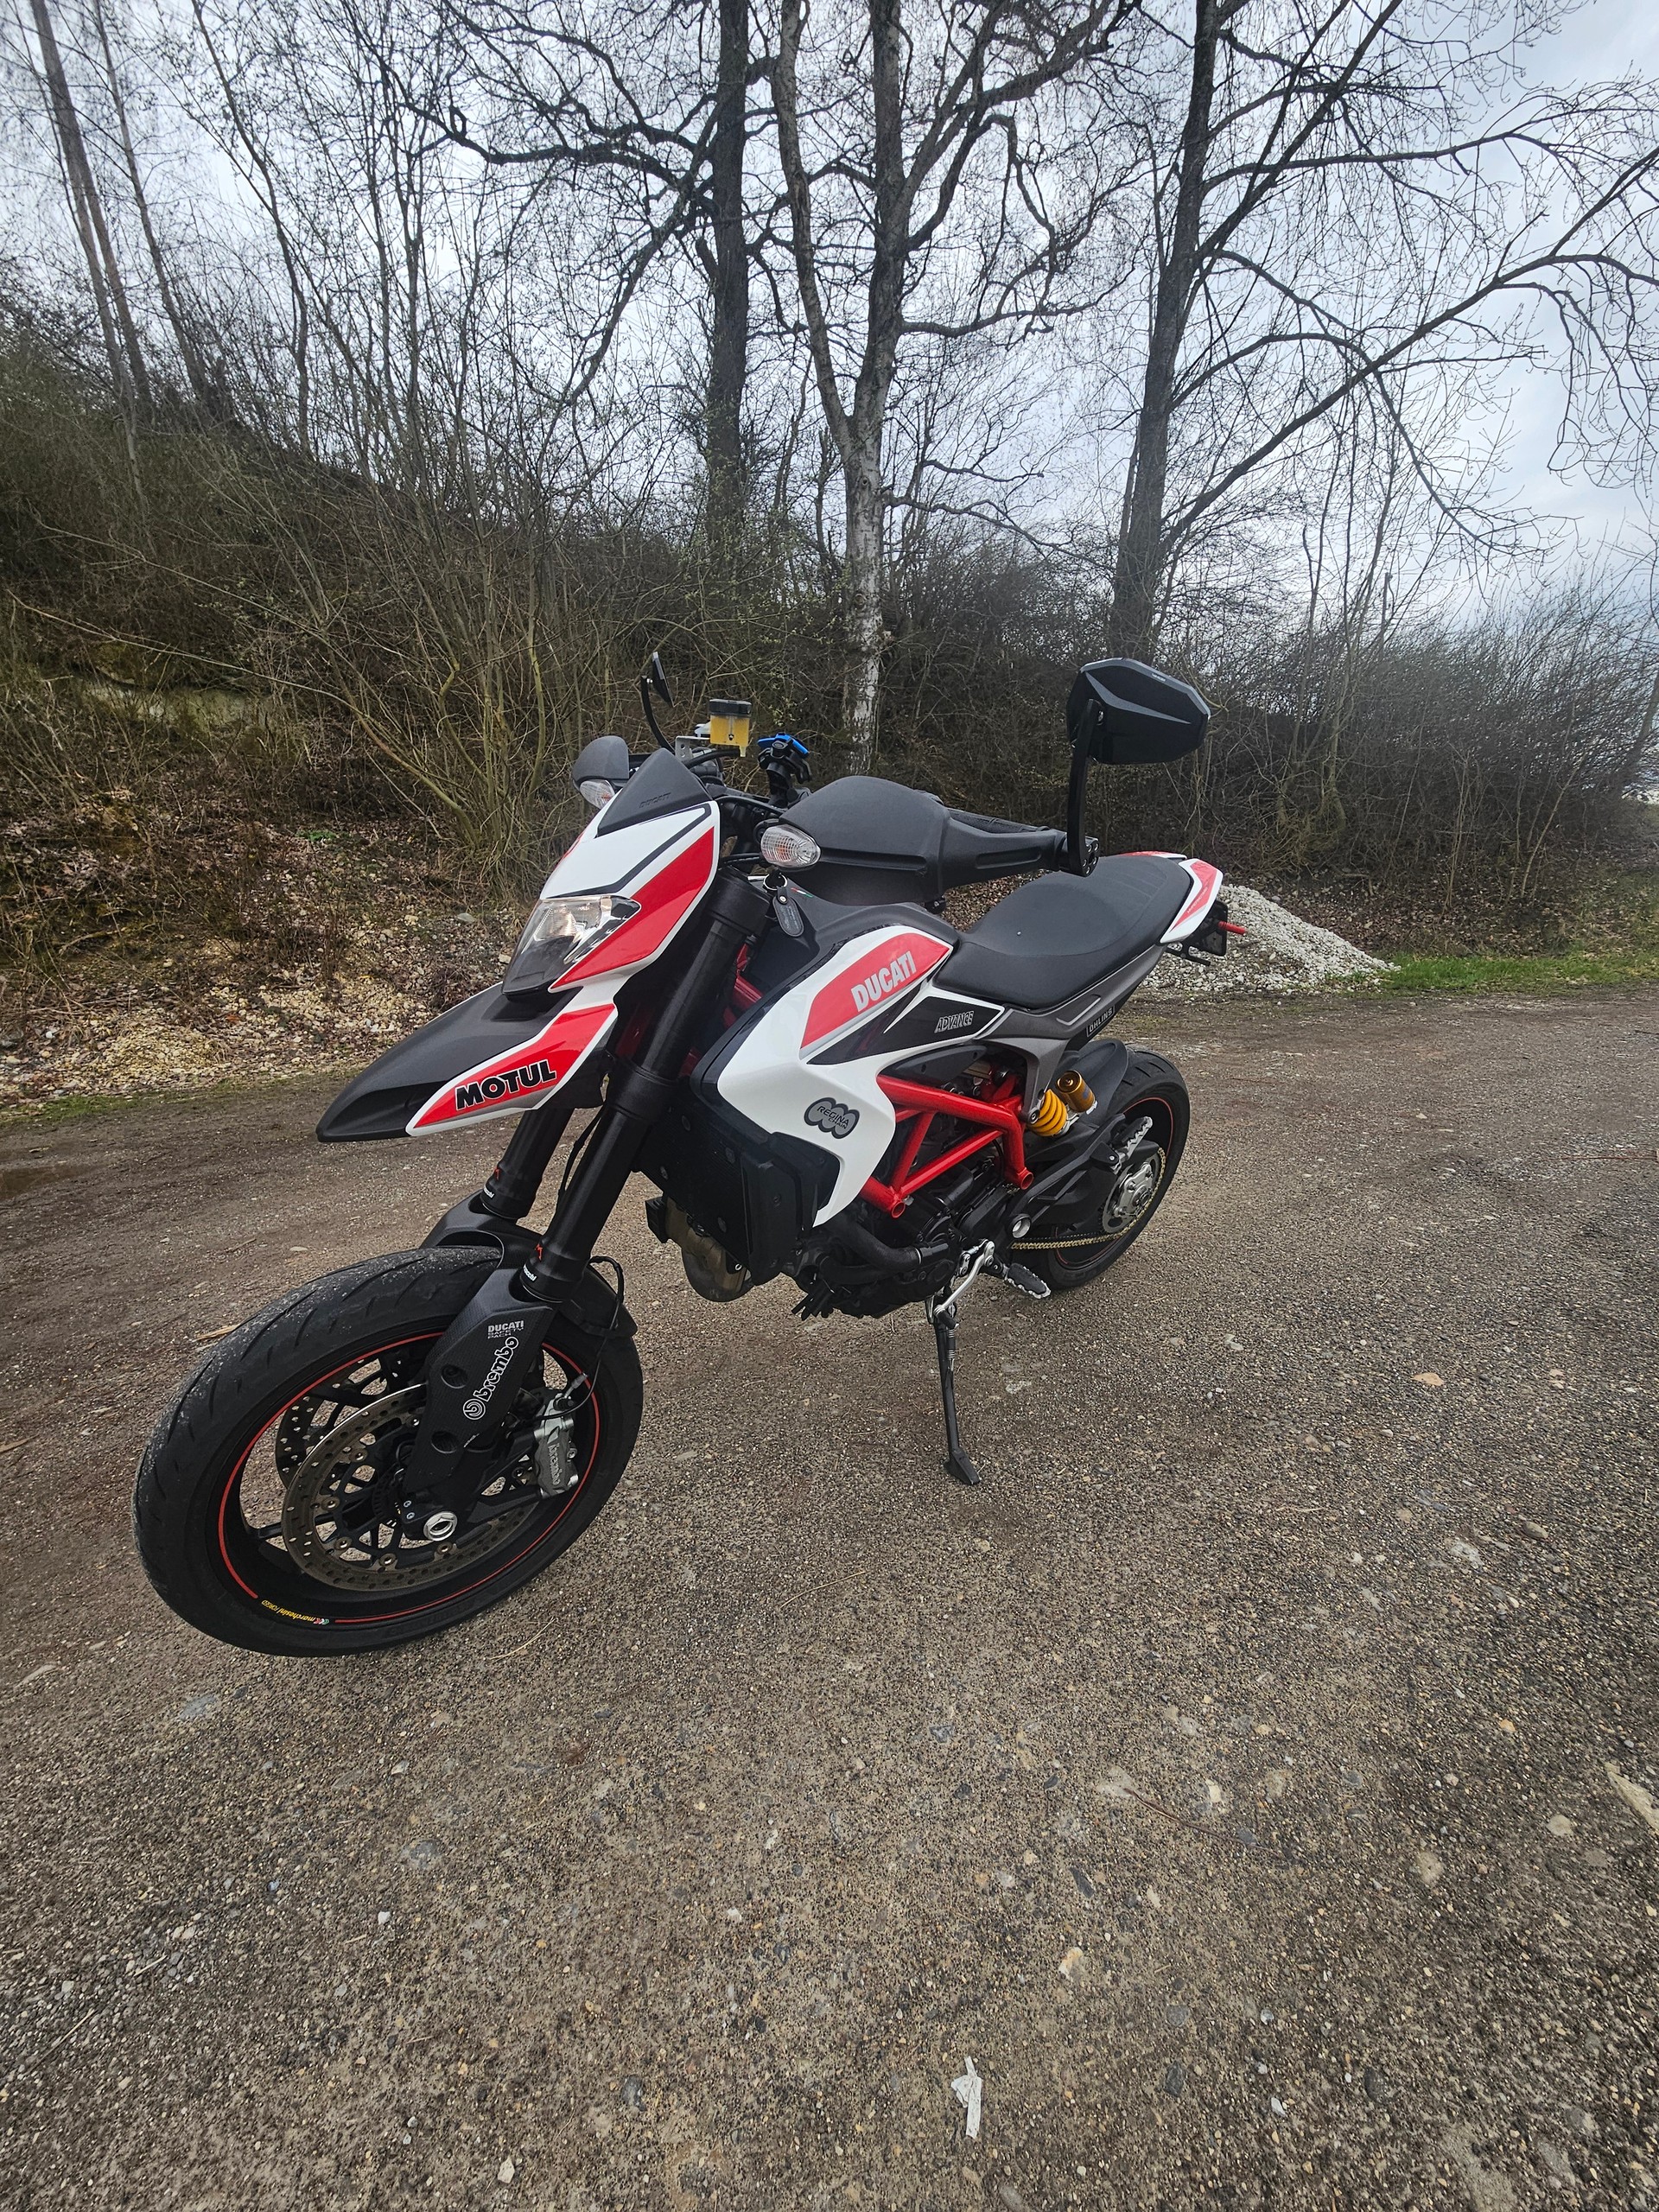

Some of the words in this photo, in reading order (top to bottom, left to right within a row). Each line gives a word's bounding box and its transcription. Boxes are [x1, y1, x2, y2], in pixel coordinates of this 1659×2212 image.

[850, 950, 917, 1013] DUCATI
[934, 1011, 975, 1033] ADVANCE
[454, 1059, 557, 1111] MOTUL
[817, 1106, 849, 1126] REGINA
[828, 1118, 848, 1129] CHAIN
[488, 1320, 524, 1332] DUCATI
[473, 1336, 518, 1402] brembo
[548, 1443, 563, 1484] brembo
